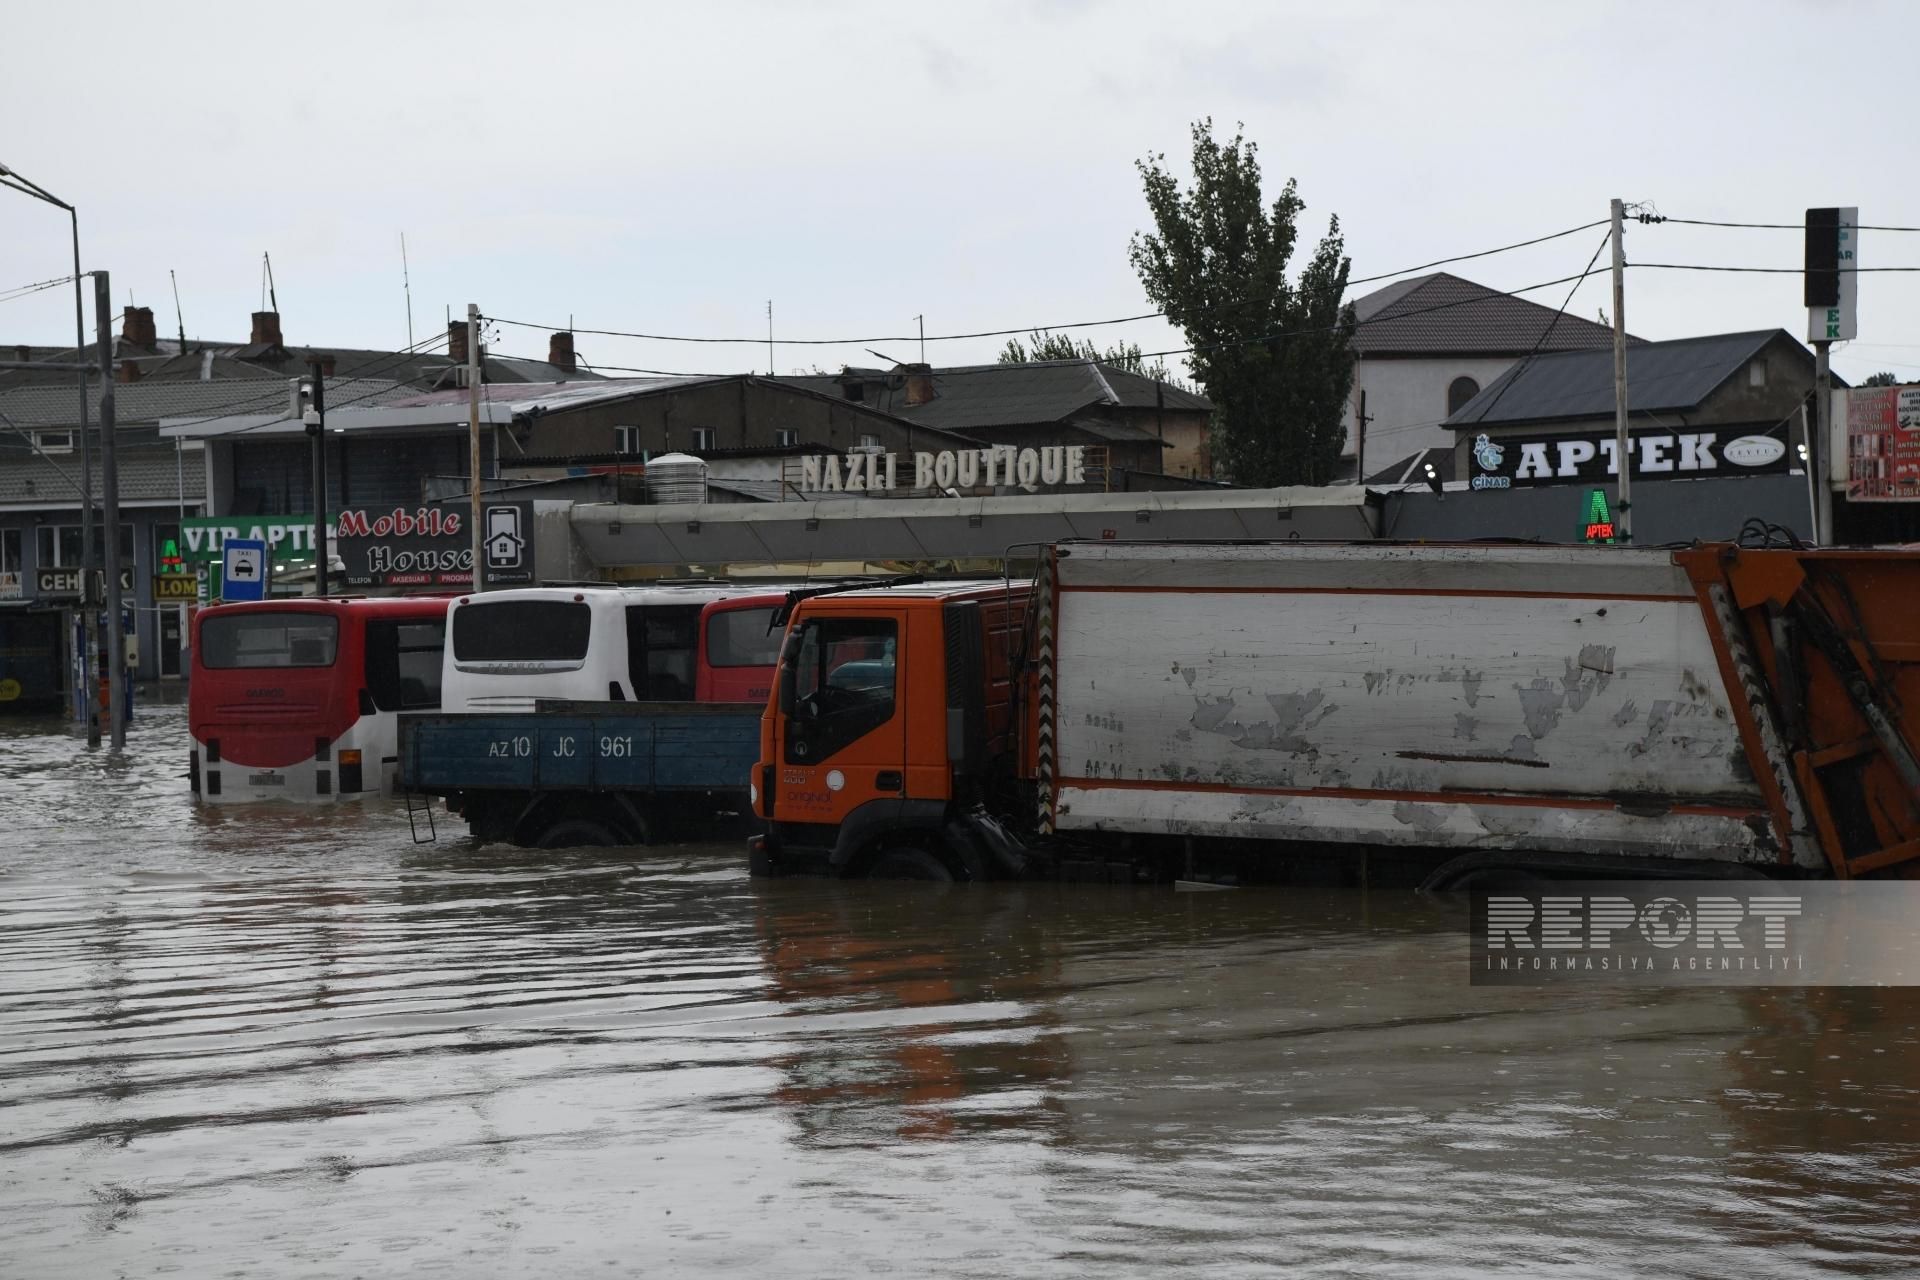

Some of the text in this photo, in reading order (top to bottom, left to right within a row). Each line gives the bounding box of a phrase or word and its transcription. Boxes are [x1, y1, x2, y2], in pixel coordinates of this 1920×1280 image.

[1516, 433, 1717, 478] APTEK
[801, 443, 1086, 493] NAZLI BOUTIQUE
[1472, 473, 1510, 490] ÇİNAR
[338, 507, 462, 537] Mobile
[1586, 523, 1614, 538] APTEK
[367, 545, 474, 573] House
[348, 576, 372, 584] TELEFON
[553, 736, 575, 757] JC
[600, 736, 632, 757] 961
